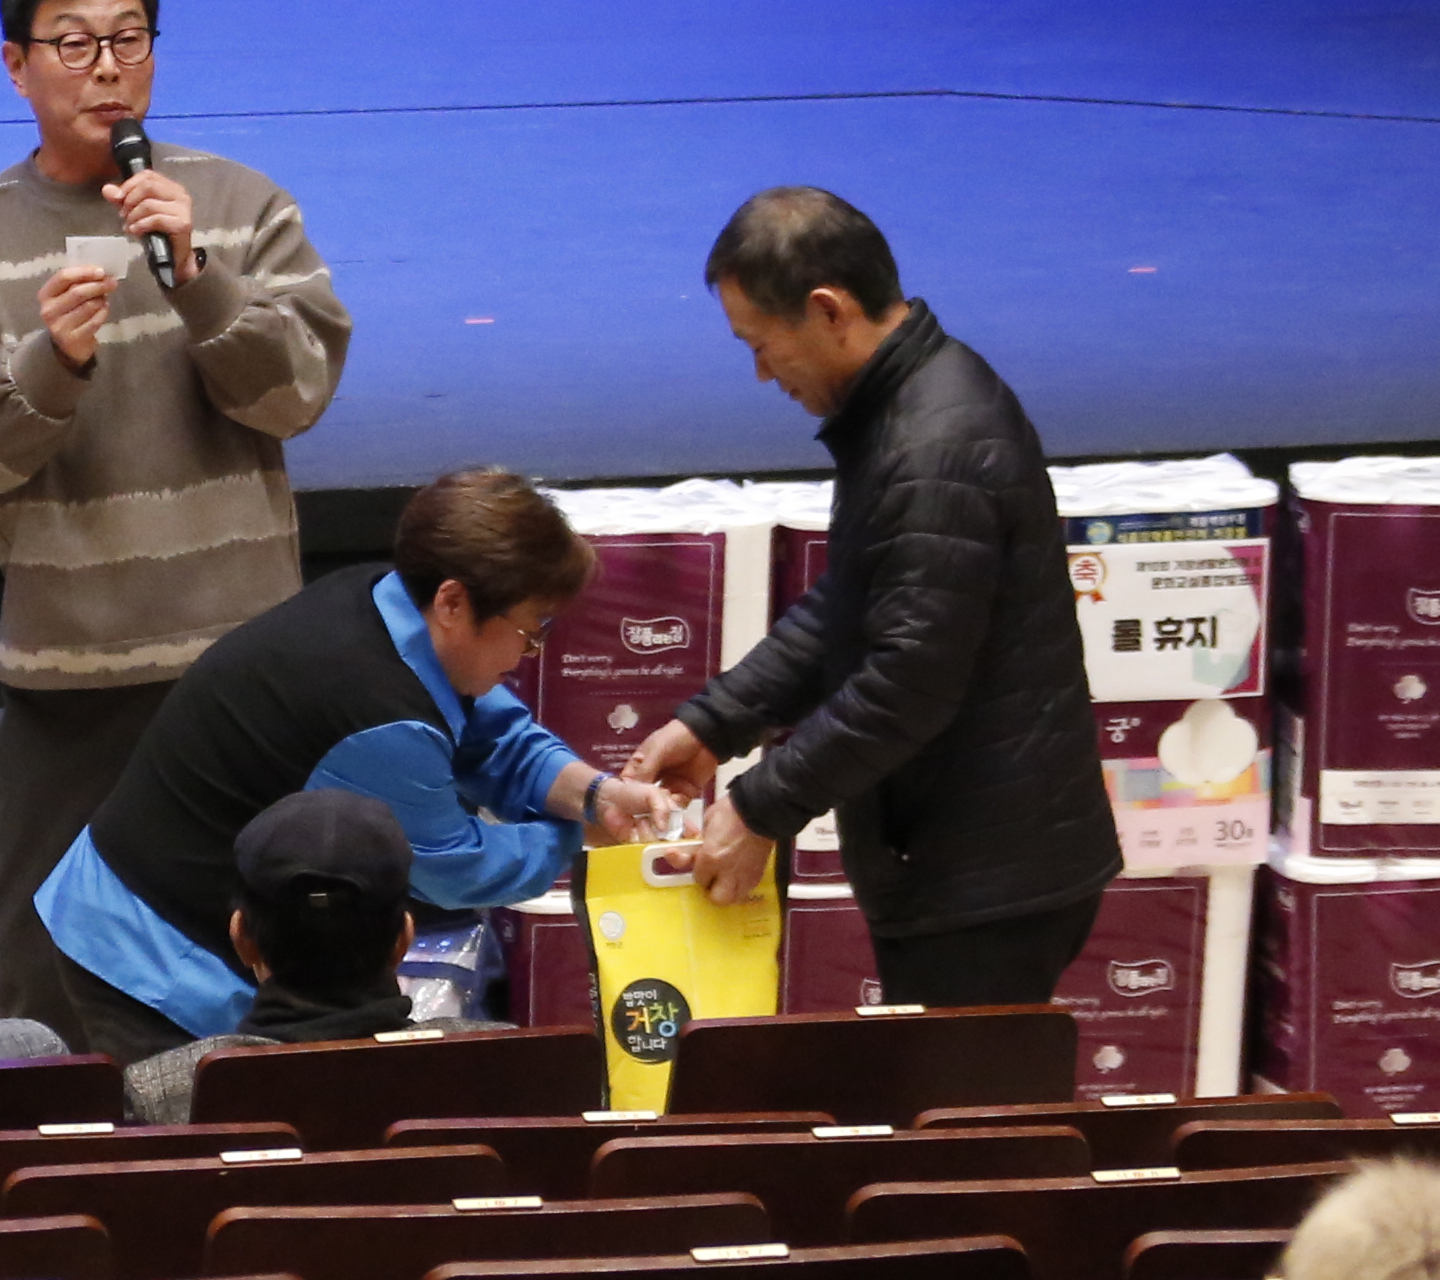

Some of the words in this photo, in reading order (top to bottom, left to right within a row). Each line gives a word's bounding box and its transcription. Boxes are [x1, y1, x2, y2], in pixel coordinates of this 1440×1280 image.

[1074, 559, 1099, 586] 축
[1153, 616, 1218, 651] 휴지
[625, 1002, 680, 1038] 거창
[627, 1035, 668, 1053] 합니다
